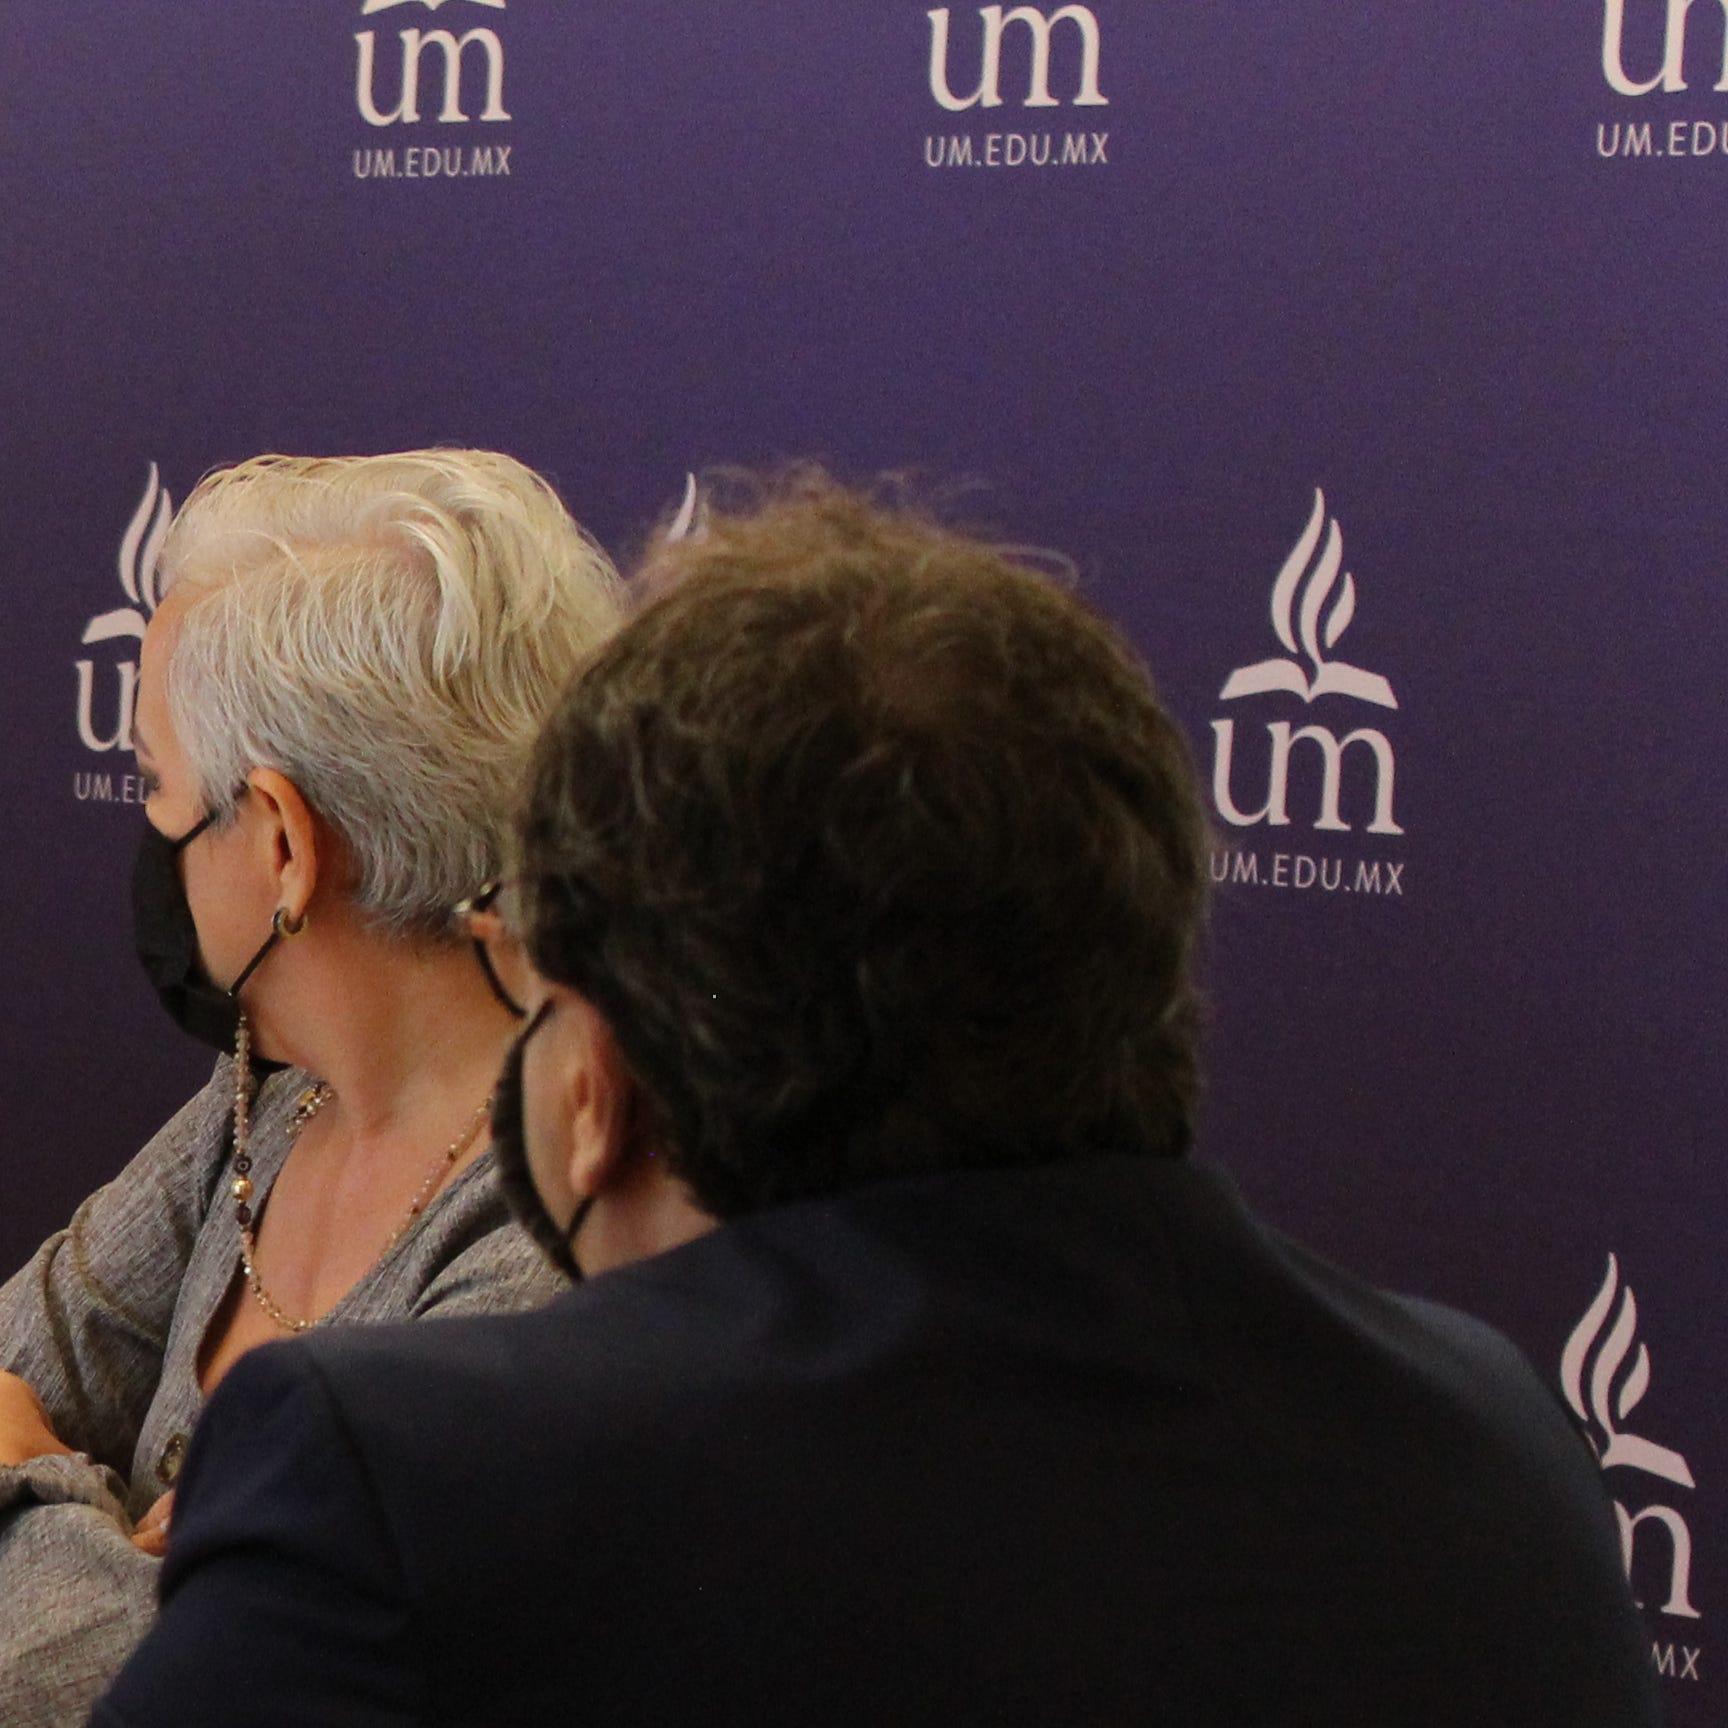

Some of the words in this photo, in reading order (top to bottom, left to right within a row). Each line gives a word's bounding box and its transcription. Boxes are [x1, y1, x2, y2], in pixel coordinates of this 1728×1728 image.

[355, 28, 512, 126] um
[927, 4, 1110, 112] um
[353, 147, 512, 178] UM.EDU.MX
[925, 132, 1109, 167] UM.EDU.MX
[1210, 719, 1405, 836] um
[1210, 851, 1404, 895] UM.EDU.MX
